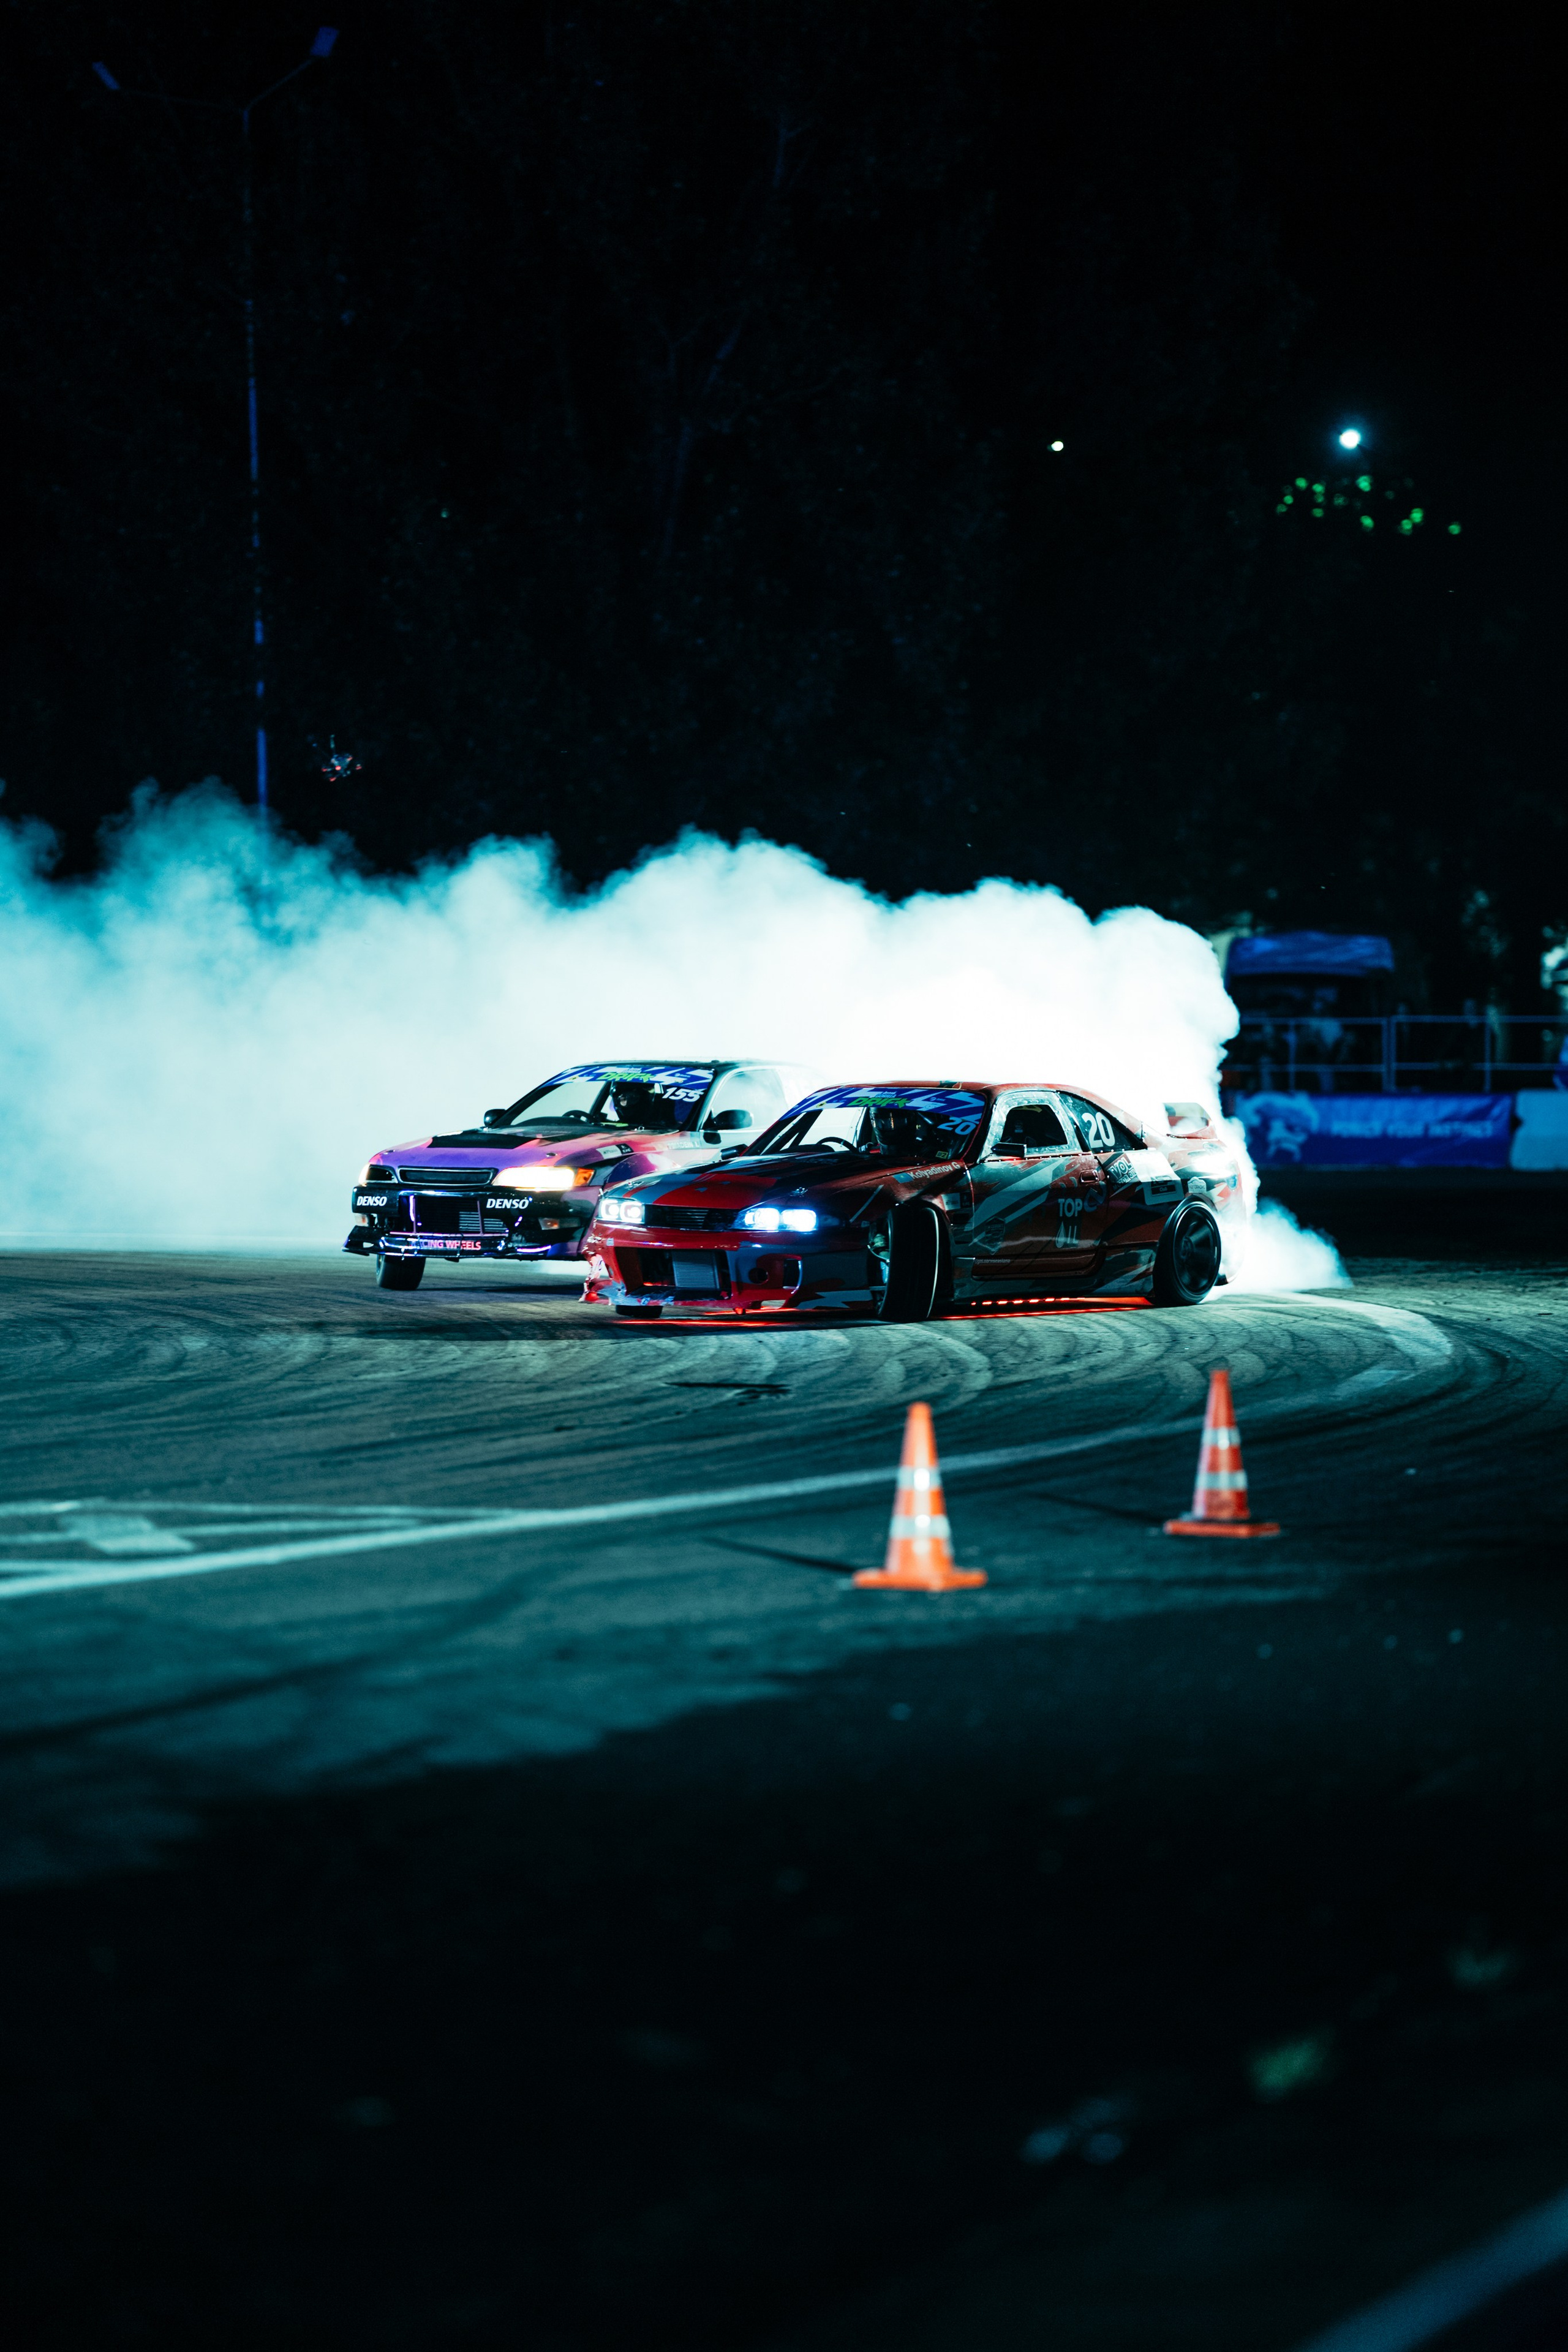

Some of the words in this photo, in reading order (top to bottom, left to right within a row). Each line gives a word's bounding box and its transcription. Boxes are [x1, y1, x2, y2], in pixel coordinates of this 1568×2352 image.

[662, 1087, 704, 1102] 155
[937, 1117, 976, 1135] 20
[1082, 1112, 1115, 1148] 20
[908, 1164, 954, 1178] Kolyadinov
[357, 1196, 387, 1206] DENSO
[486, 1199, 529, 1208] DENSO
[1058, 1198, 1083, 1217] TOP
